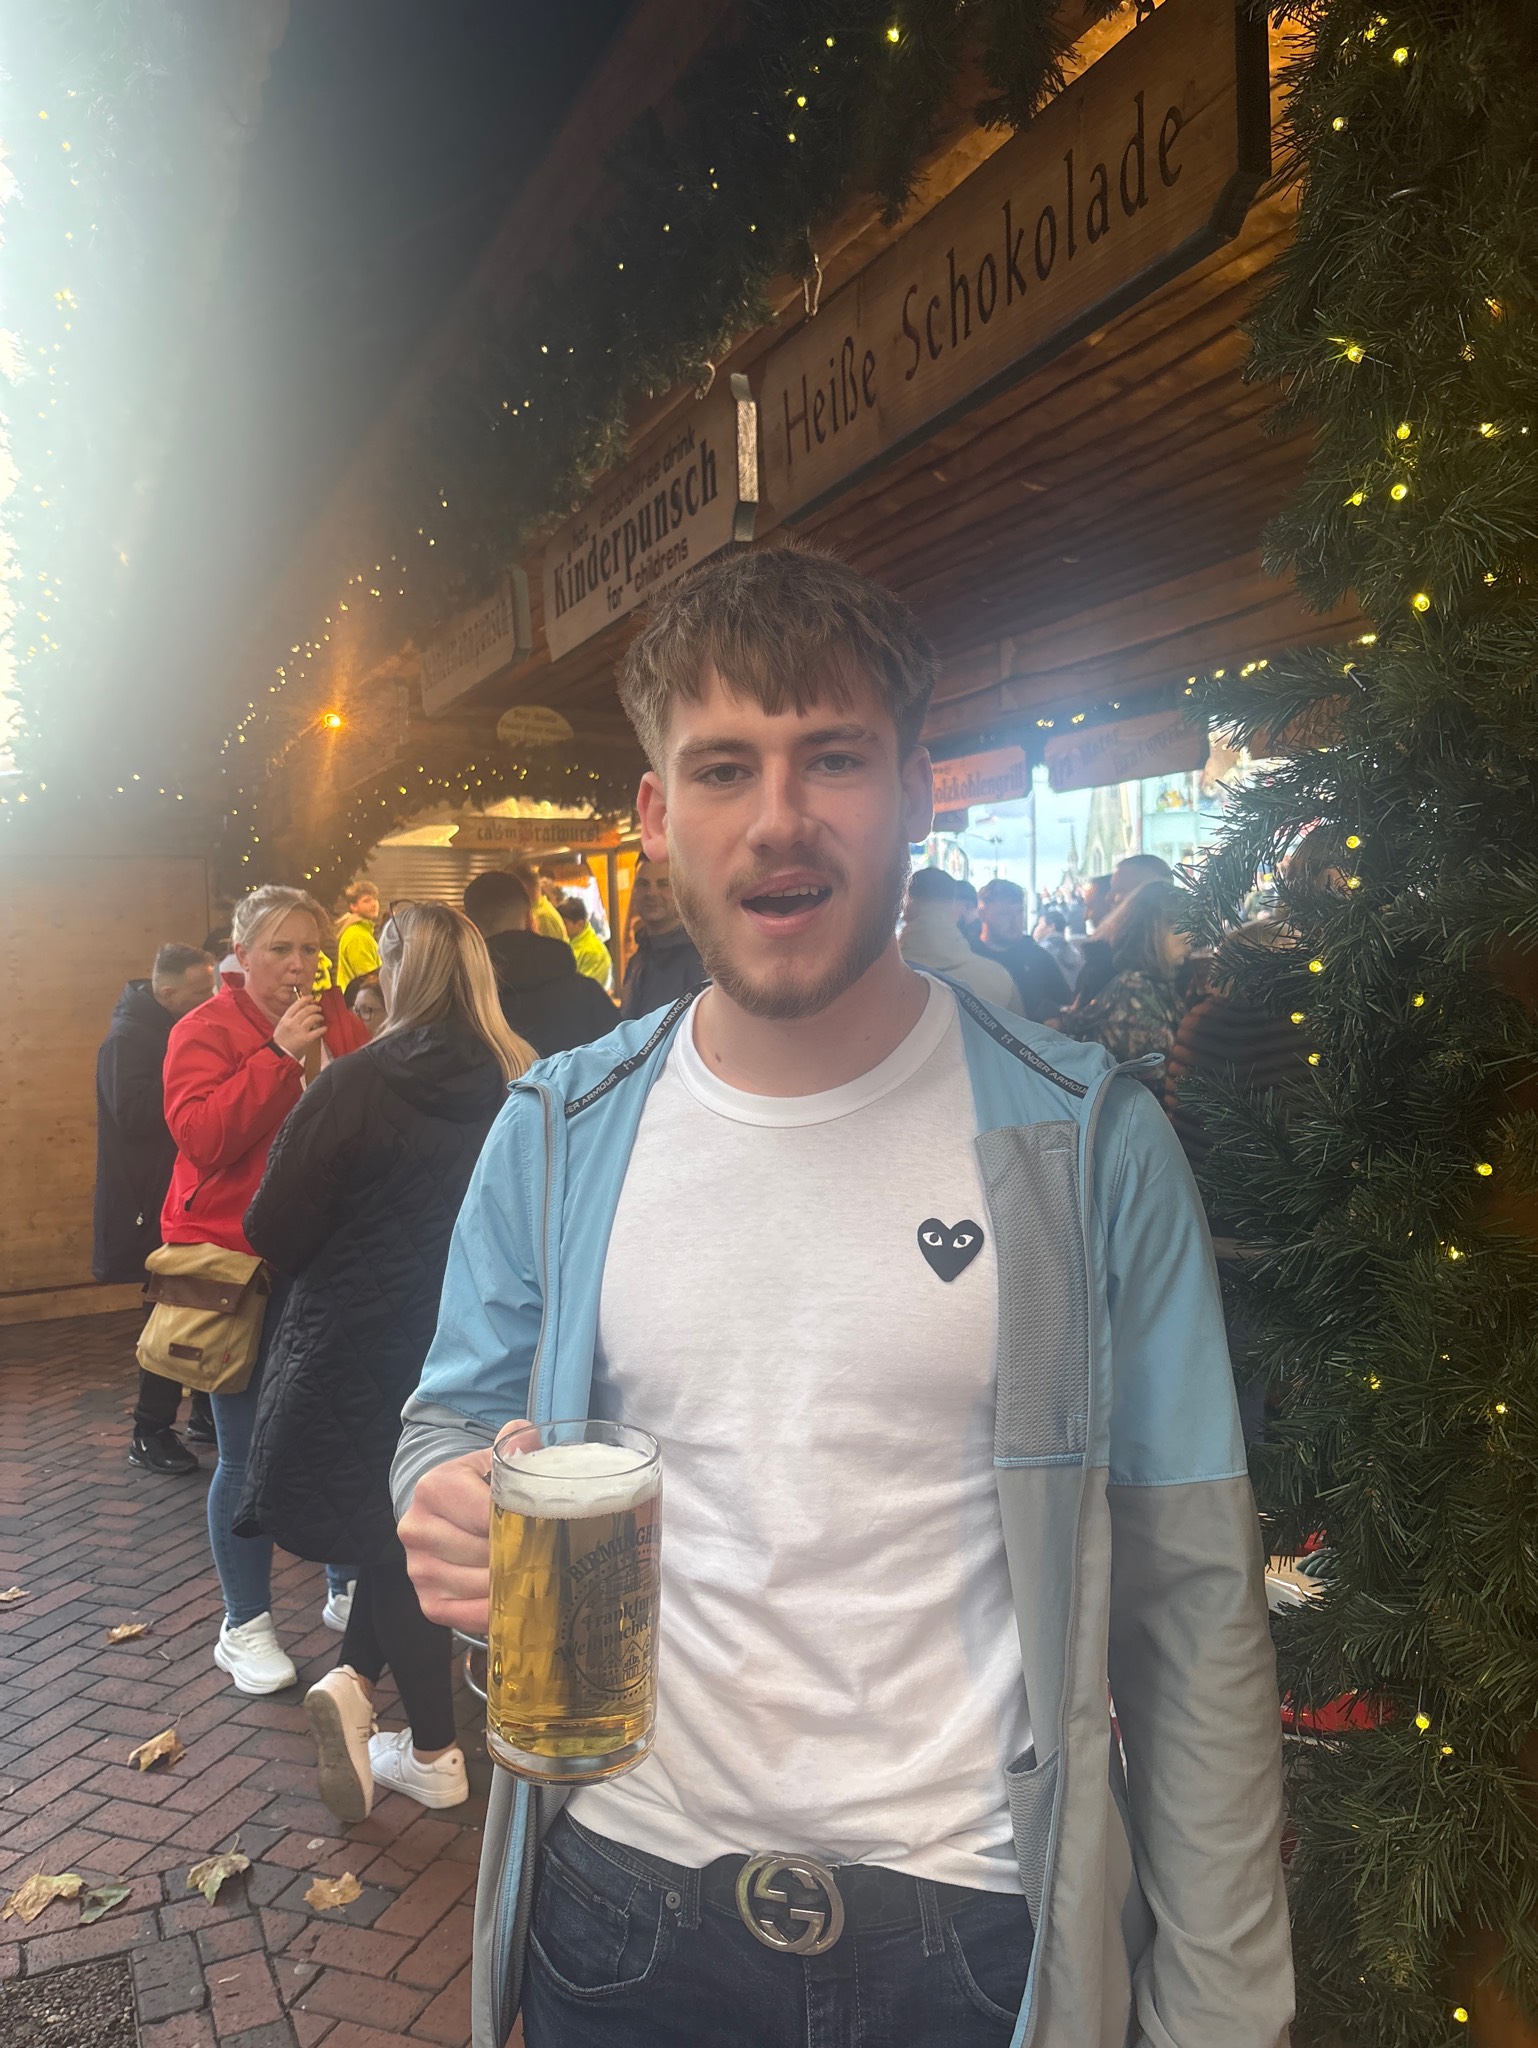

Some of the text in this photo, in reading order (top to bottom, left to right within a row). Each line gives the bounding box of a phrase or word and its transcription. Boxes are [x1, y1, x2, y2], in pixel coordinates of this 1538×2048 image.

[783, 90, 1184, 466] Heiße Schokolade
[662, 423, 695, 474] drink
[553, 438, 719, 619] Kinderpunsch
[606, 536, 689, 614] for childrens
[639, 992, 695, 1056] UNDER ARMOUR
[965, 996, 998, 1031] ARMOUR
[1019, 1047, 1051, 1073] UNDER
[581, 1073, 618, 1106] ARMOUR
